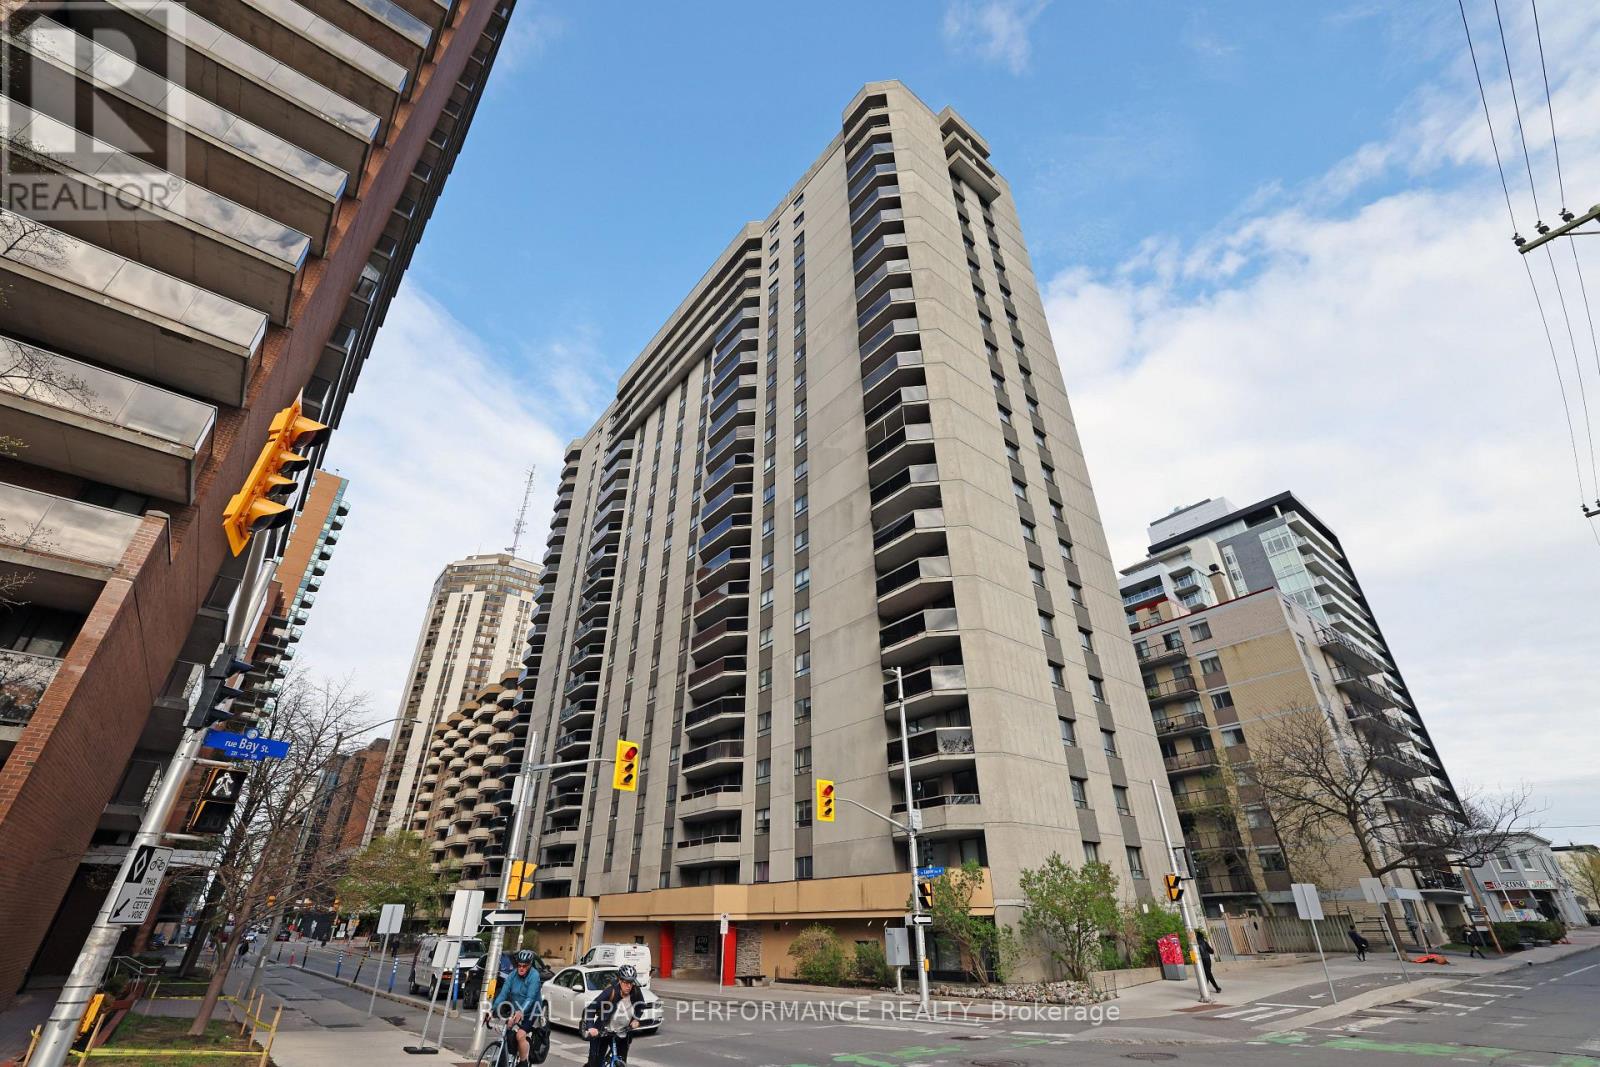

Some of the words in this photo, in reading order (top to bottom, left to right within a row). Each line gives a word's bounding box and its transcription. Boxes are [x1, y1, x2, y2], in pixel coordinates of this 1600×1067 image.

[225, 740, 237, 748] rue
[239, 738, 259, 753] Bay
[145, 877, 157, 886] THIS
[139, 887, 154, 896] LANE
[132, 900, 150, 909] CETTE
[131, 910, 144, 919] VOIE
